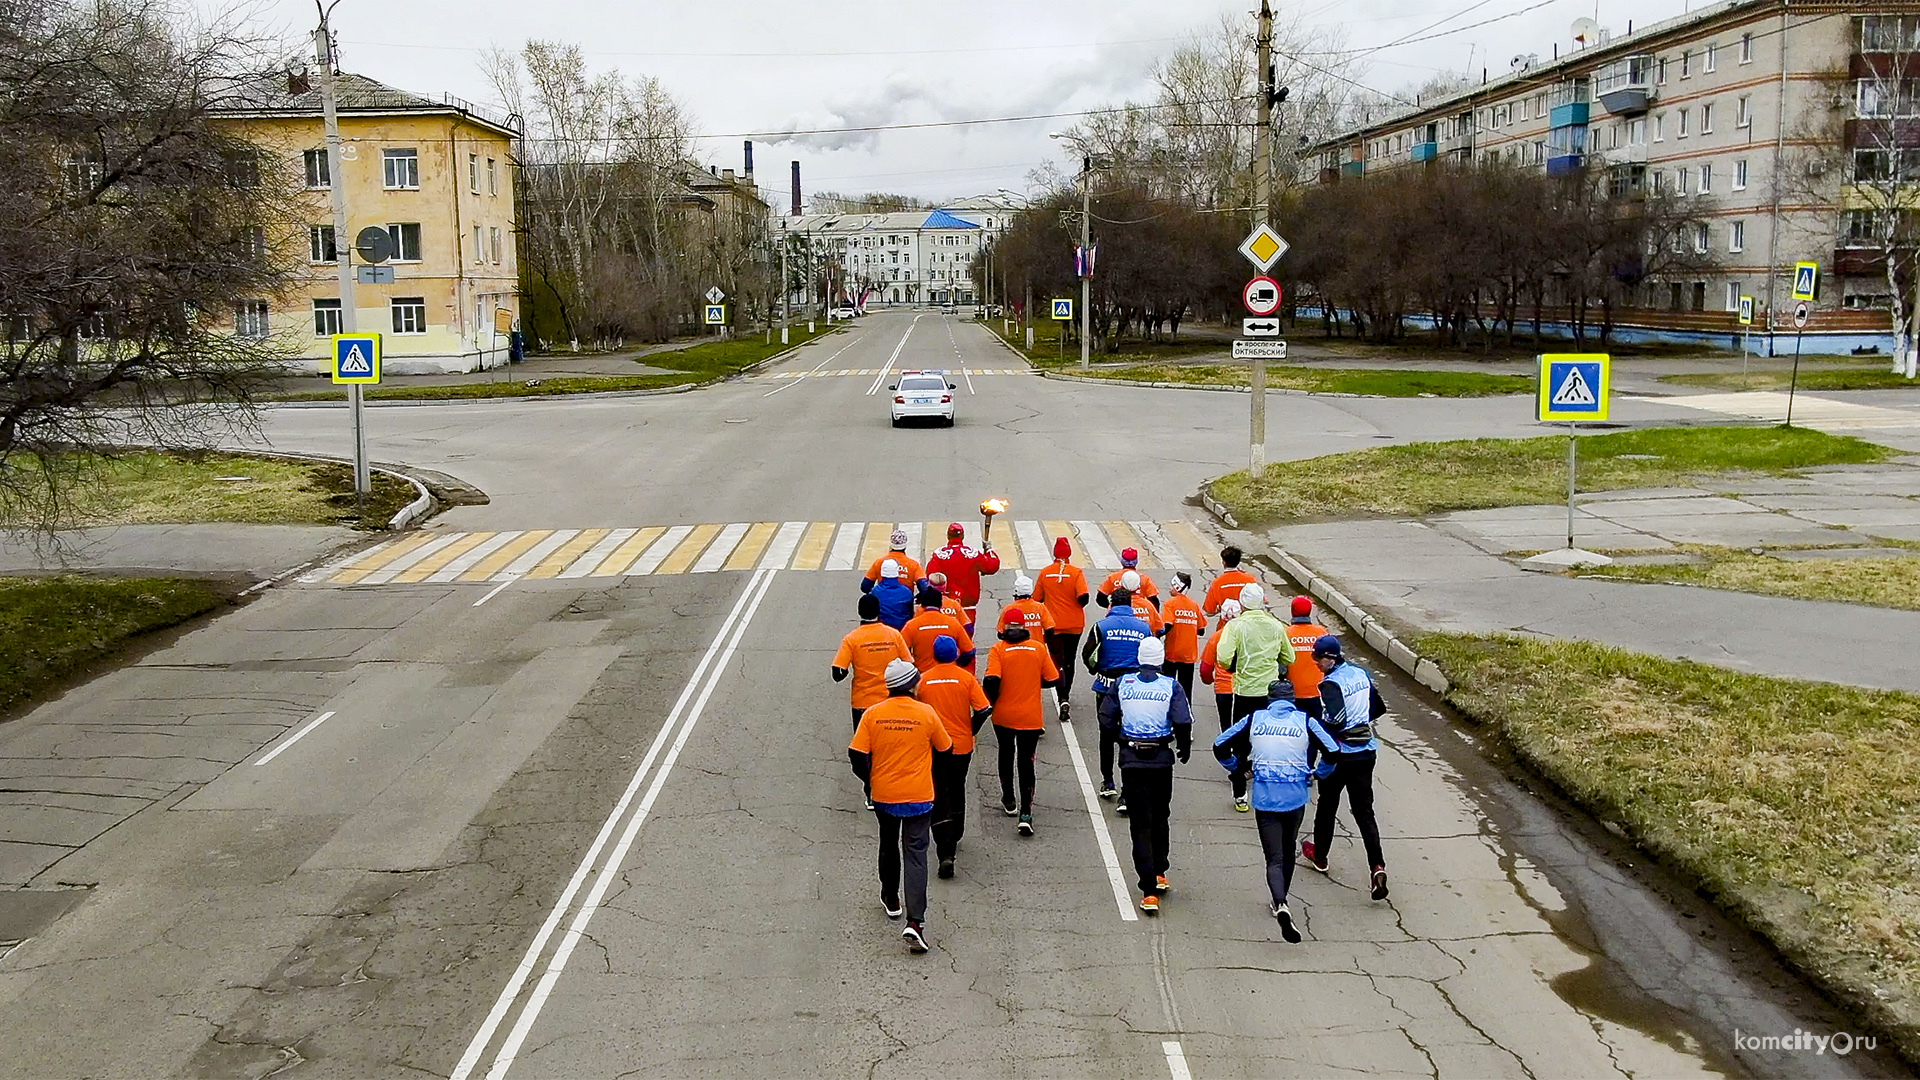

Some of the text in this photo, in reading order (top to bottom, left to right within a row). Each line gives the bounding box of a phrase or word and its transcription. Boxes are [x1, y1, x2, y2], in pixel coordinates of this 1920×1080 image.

[1235, 348, 1286, 356] ОКТЯБРЬСКИЙ
[1106, 629, 1145, 639] DYNAMO
[1291, 636, 1317, 644] СОКО
[1253, 722, 1304, 738] Динамо
